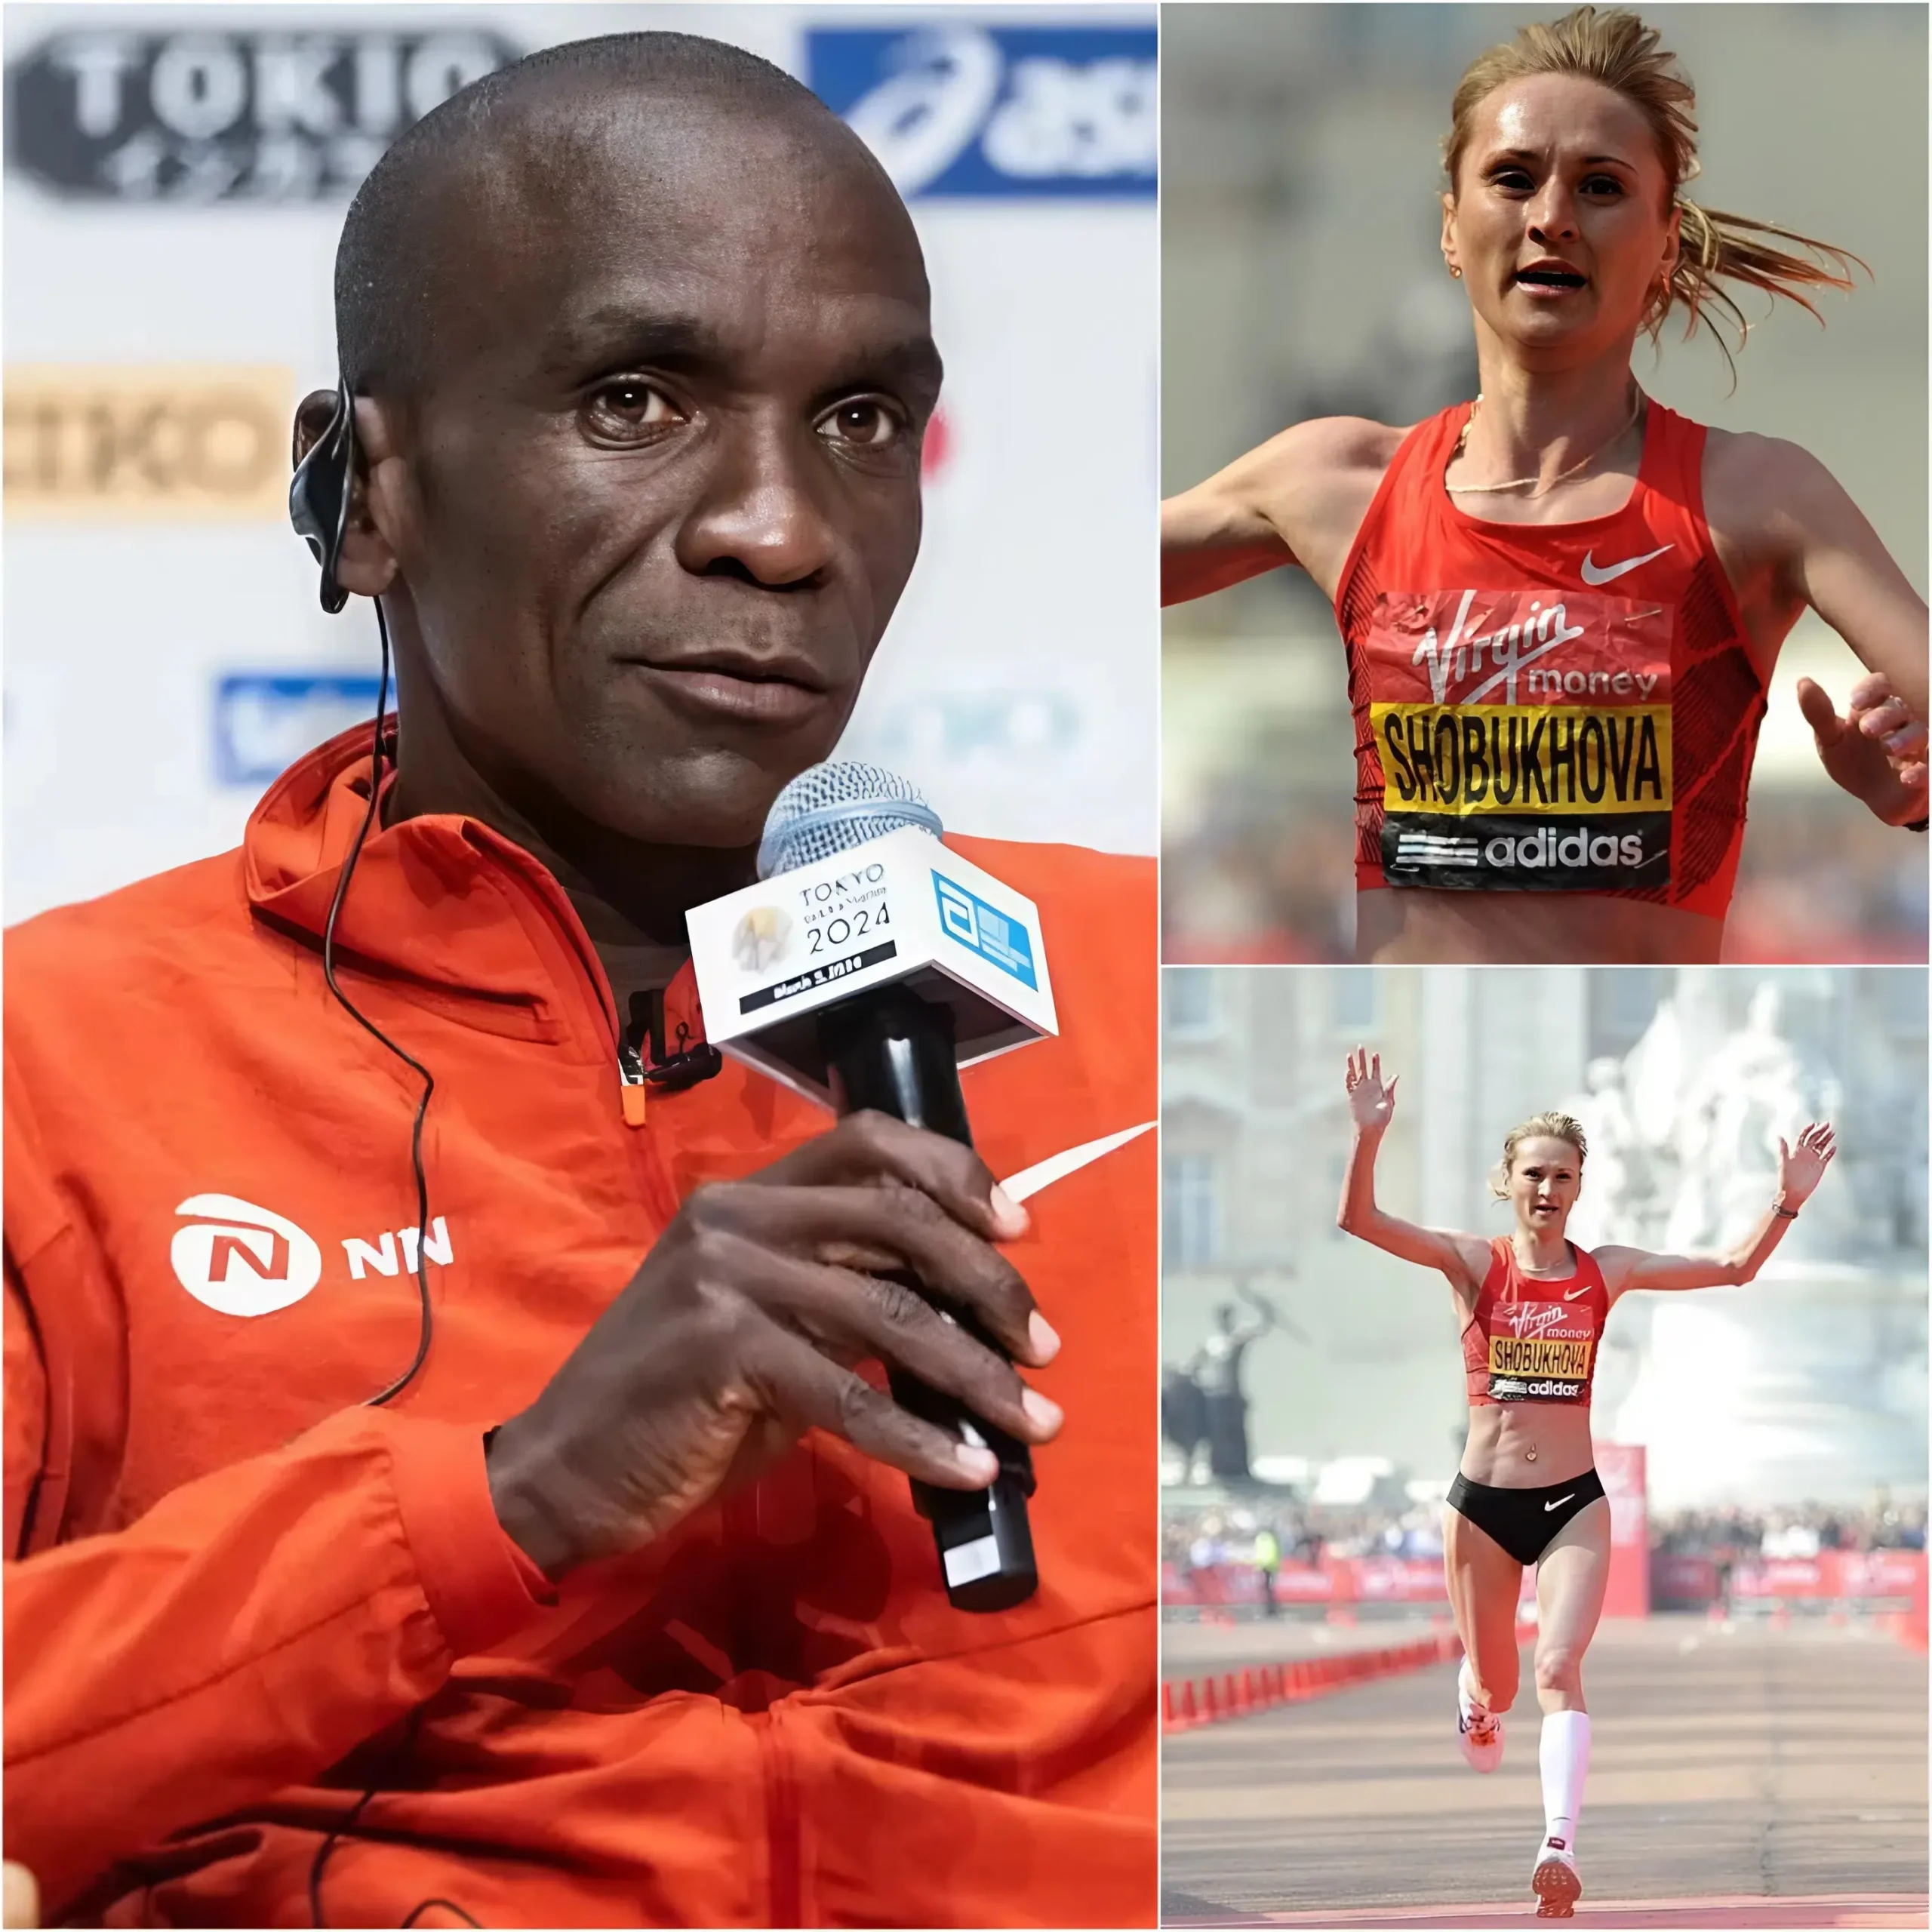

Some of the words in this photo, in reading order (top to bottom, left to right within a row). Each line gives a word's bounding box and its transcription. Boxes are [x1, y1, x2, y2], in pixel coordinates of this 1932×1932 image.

[1412, 589, 1584, 704] Virgin
[1527, 666, 1658, 700] money
[1384, 712, 1663, 805] SHOBUKHOVA
[1484, 827, 1643, 868] adidas
[807, 901, 890, 955] 2024
[341, 1216, 454, 1280] NN
[1509, 1301, 1567, 1340] Virgin
[1495, 1340, 1586, 1375] SHOBUKHOVA
[1528, 1380, 1579, 1396] adidas
